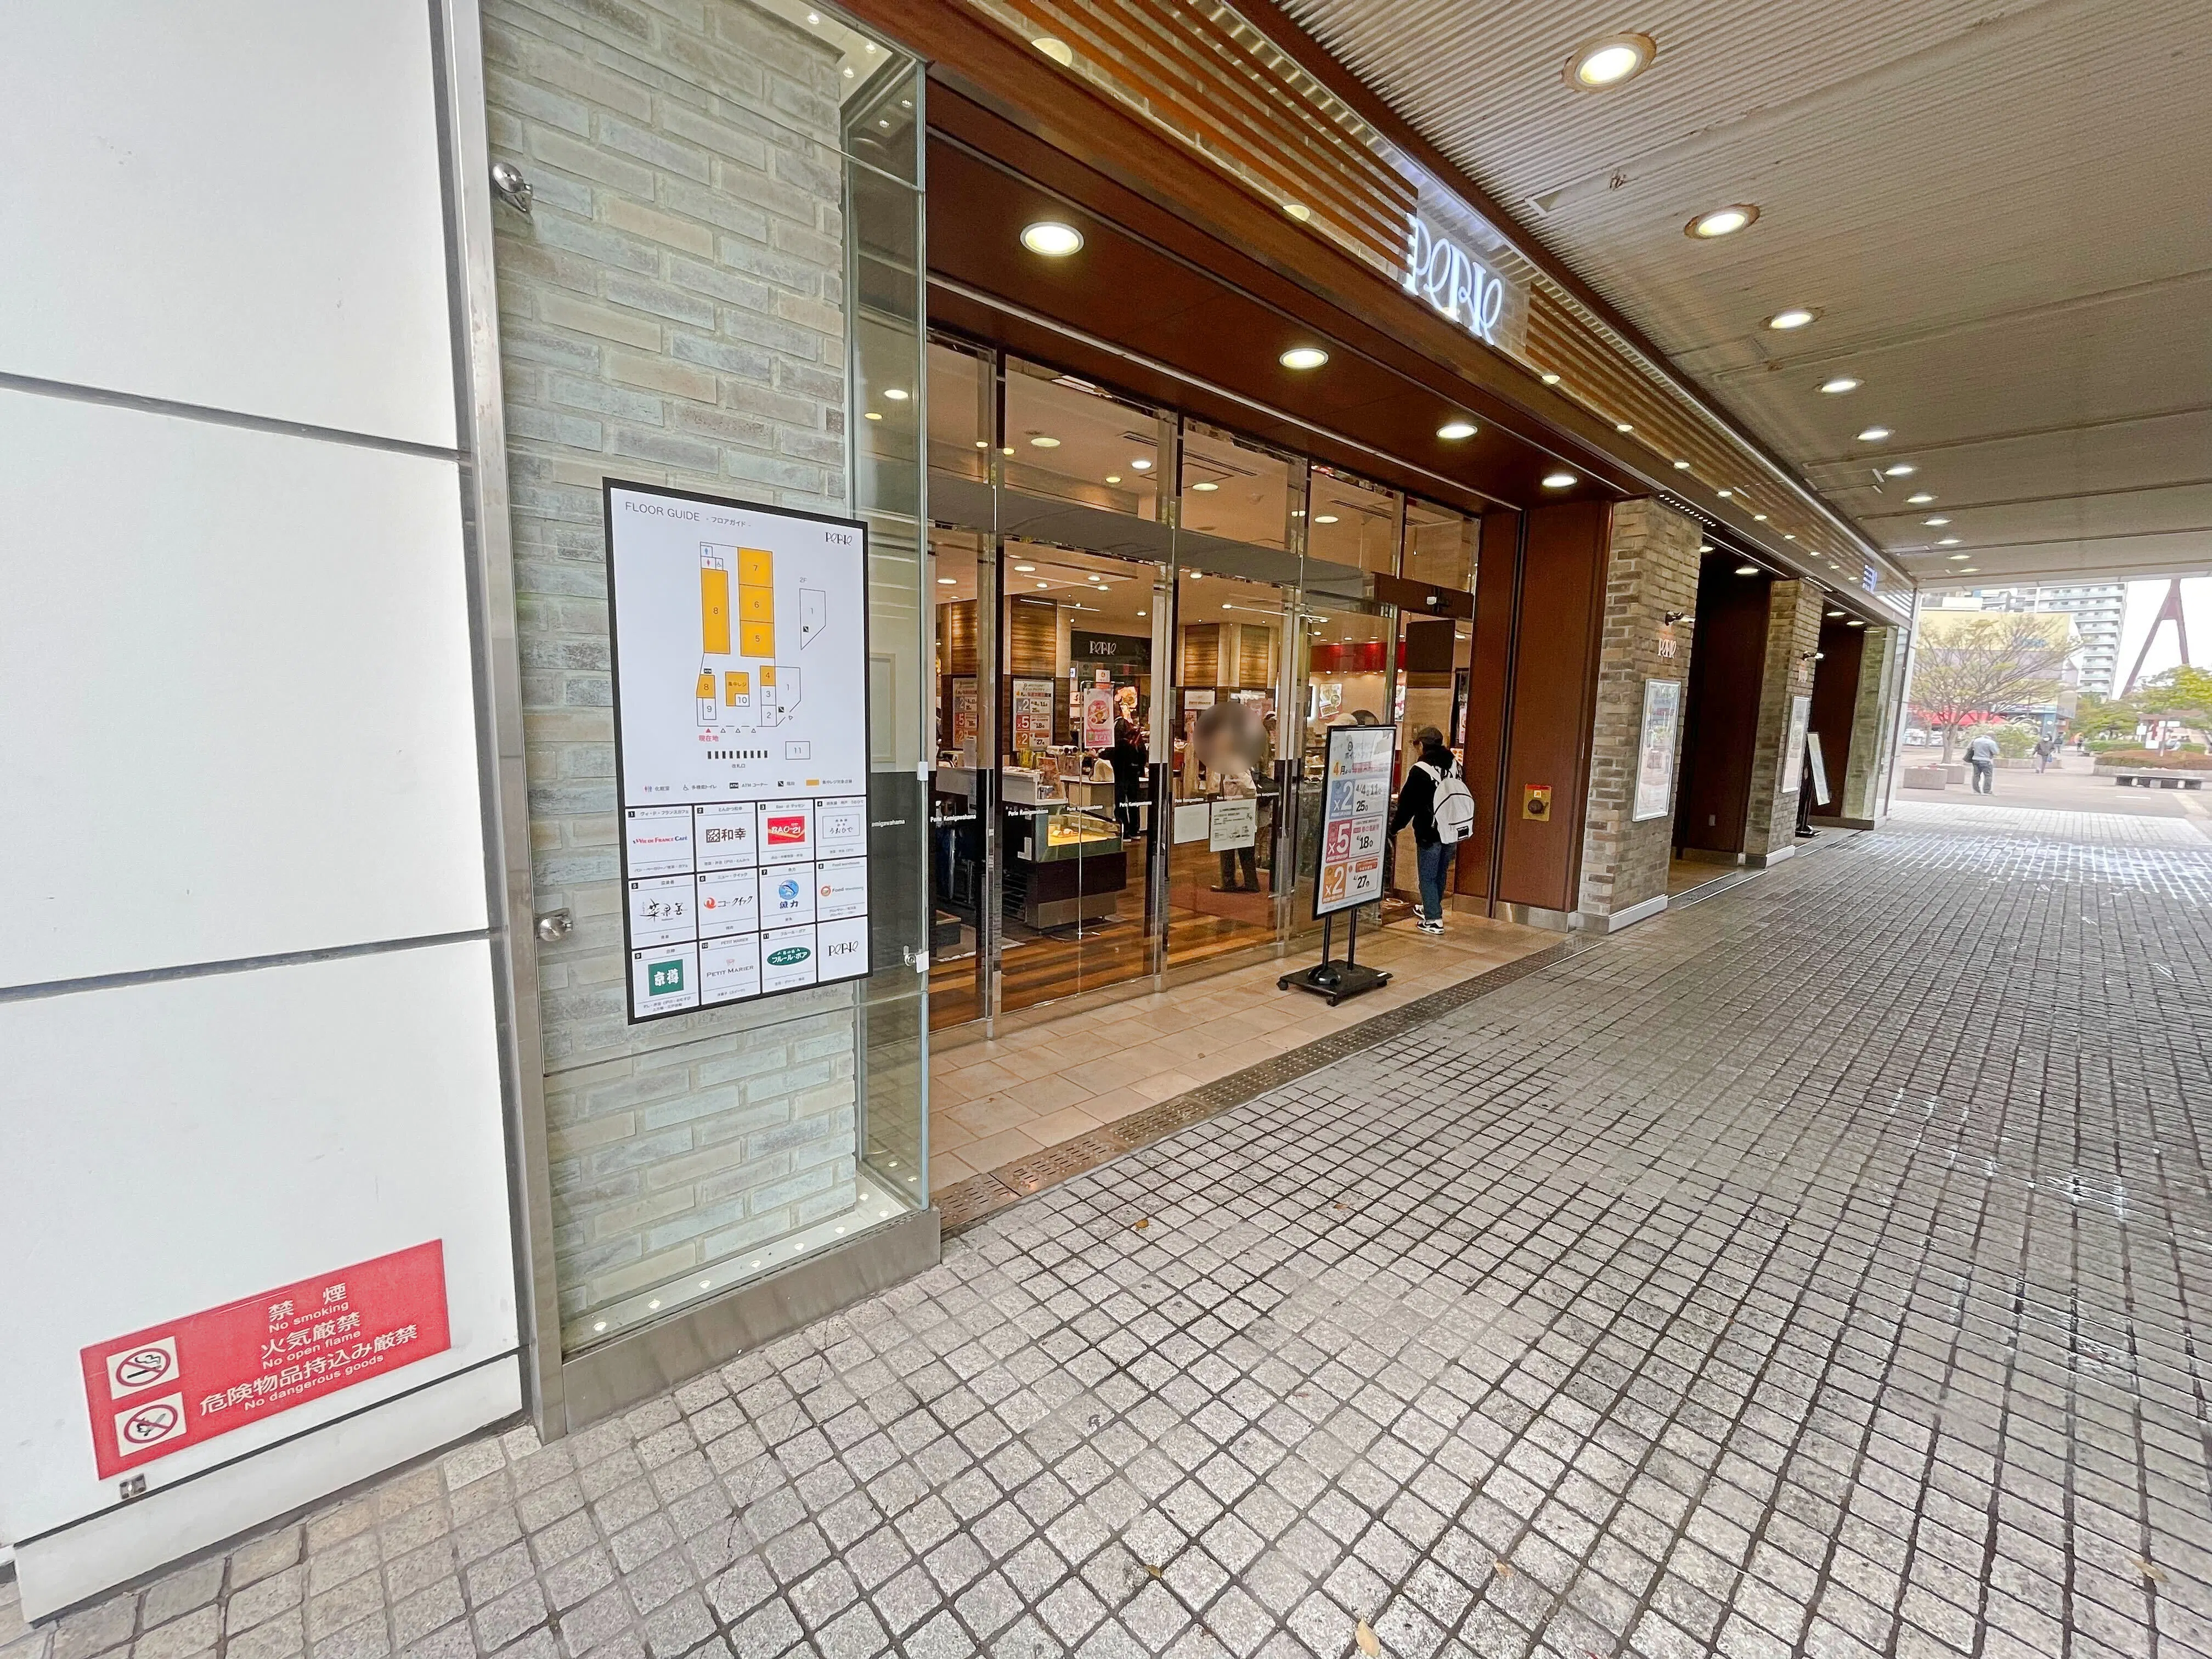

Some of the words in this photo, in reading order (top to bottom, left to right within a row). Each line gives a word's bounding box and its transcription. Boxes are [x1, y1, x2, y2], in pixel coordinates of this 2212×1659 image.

[625, 501, 664, 516] FLOOR
[667, 508, 700, 522] GUIDE
[711, 517, 746, 527] フロアガイド
[721, 827, 747, 841] 和幸
[706, 970, 726, 978] PETIT
[727, 965, 754, 974] MARIER
[268, 1318, 290, 1334] No
[292, 1301, 349, 1328] smoking
[259, 1311, 362, 1359] 火気厳禁
[262, 1355, 284, 1370] No
[286, 1343, 321, 1365] open
[324, 1329, 362, 1350] flame
[199, 1323, 419, 1417] 危険物品持込み厳禁
[244, 1396, 266, 1412] No
[269, 1370, 341, 1402] dangerous
[345, 1353, 384, 1378] goods
